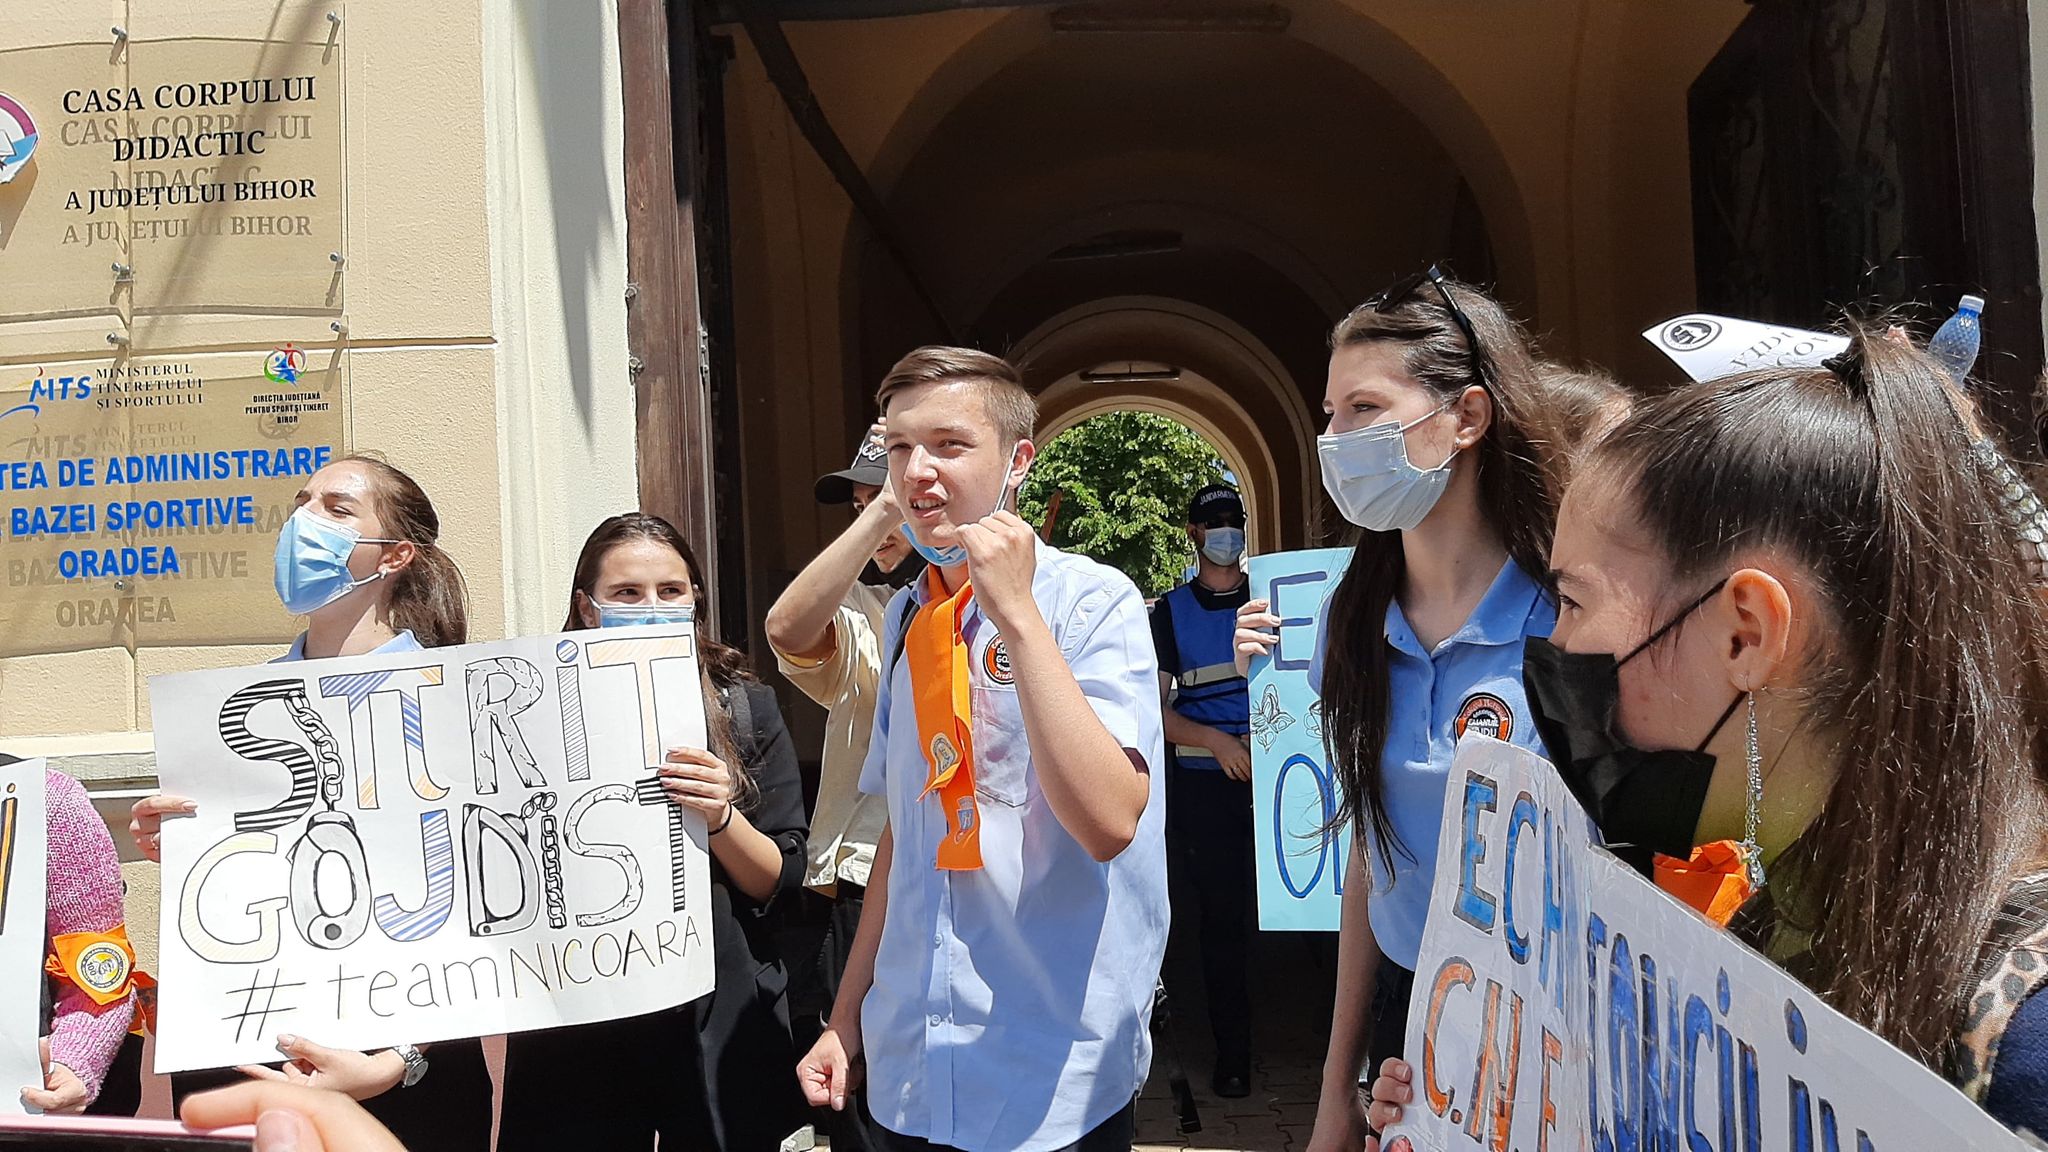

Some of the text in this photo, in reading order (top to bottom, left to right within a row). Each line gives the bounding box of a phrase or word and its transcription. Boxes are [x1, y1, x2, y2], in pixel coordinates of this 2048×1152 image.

[62, 76, 316, 114] CASA CORPULUI
[113, 130, 266, 162] DIDACTIC
[64, 178, 317, 215] A JUDEȚULUI BIHOR
[96, 363, 194, 379] MINISTERUL
[96, 378, 204, 394] TINERETULUI
[28, 375, 92, 403] MTS
[115, 393, 203, 409] SPORTULUI
[245, 405, 271, 415] PENTRU
[271, 404, 294, 414] SPORT
[303, 402, 329, 413] TINERET
[276, 414, 298, 425] BIHOR
[58, 457, 95, 489] DE
[105, 445, 332, 486] ADMINISTRARE
[11, 494, 255, 537] BAZEI SPORTIVE
[58, 545, 180, 580] ORADEA
